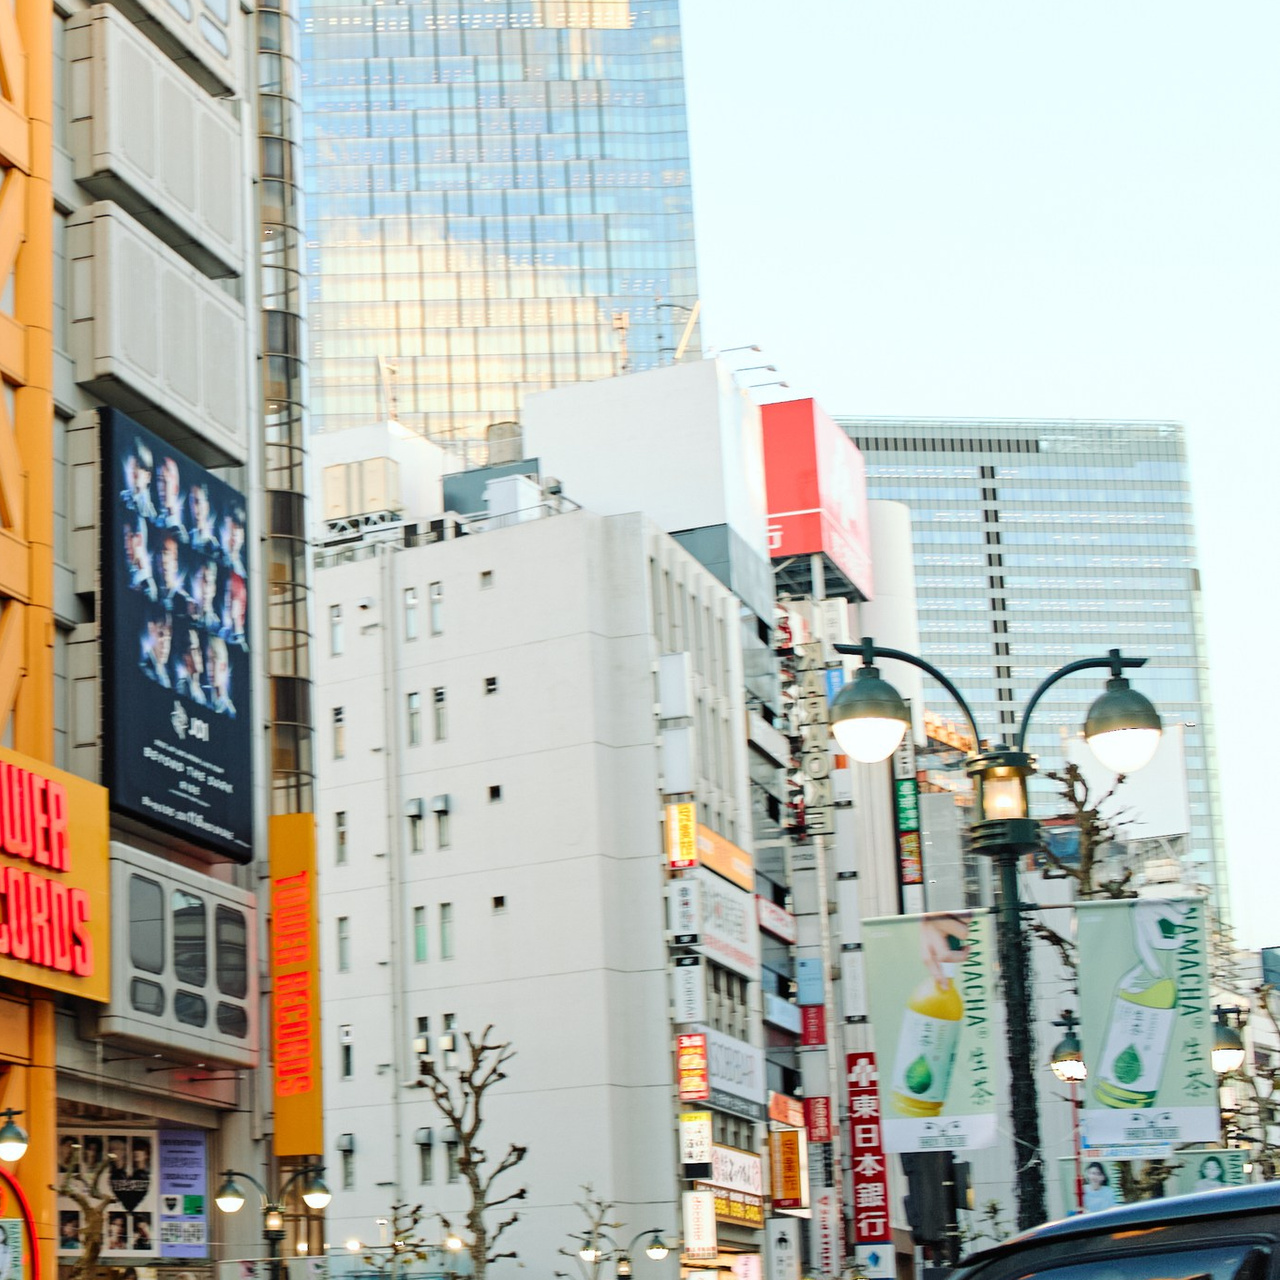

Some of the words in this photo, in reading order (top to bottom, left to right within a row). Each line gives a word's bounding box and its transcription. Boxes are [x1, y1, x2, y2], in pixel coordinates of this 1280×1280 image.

[273, 869, 312, 968] TOWER
[274, 970, 315, 1098] RECORDS
[851, 1095, 888, 1237] 東日本銀行
